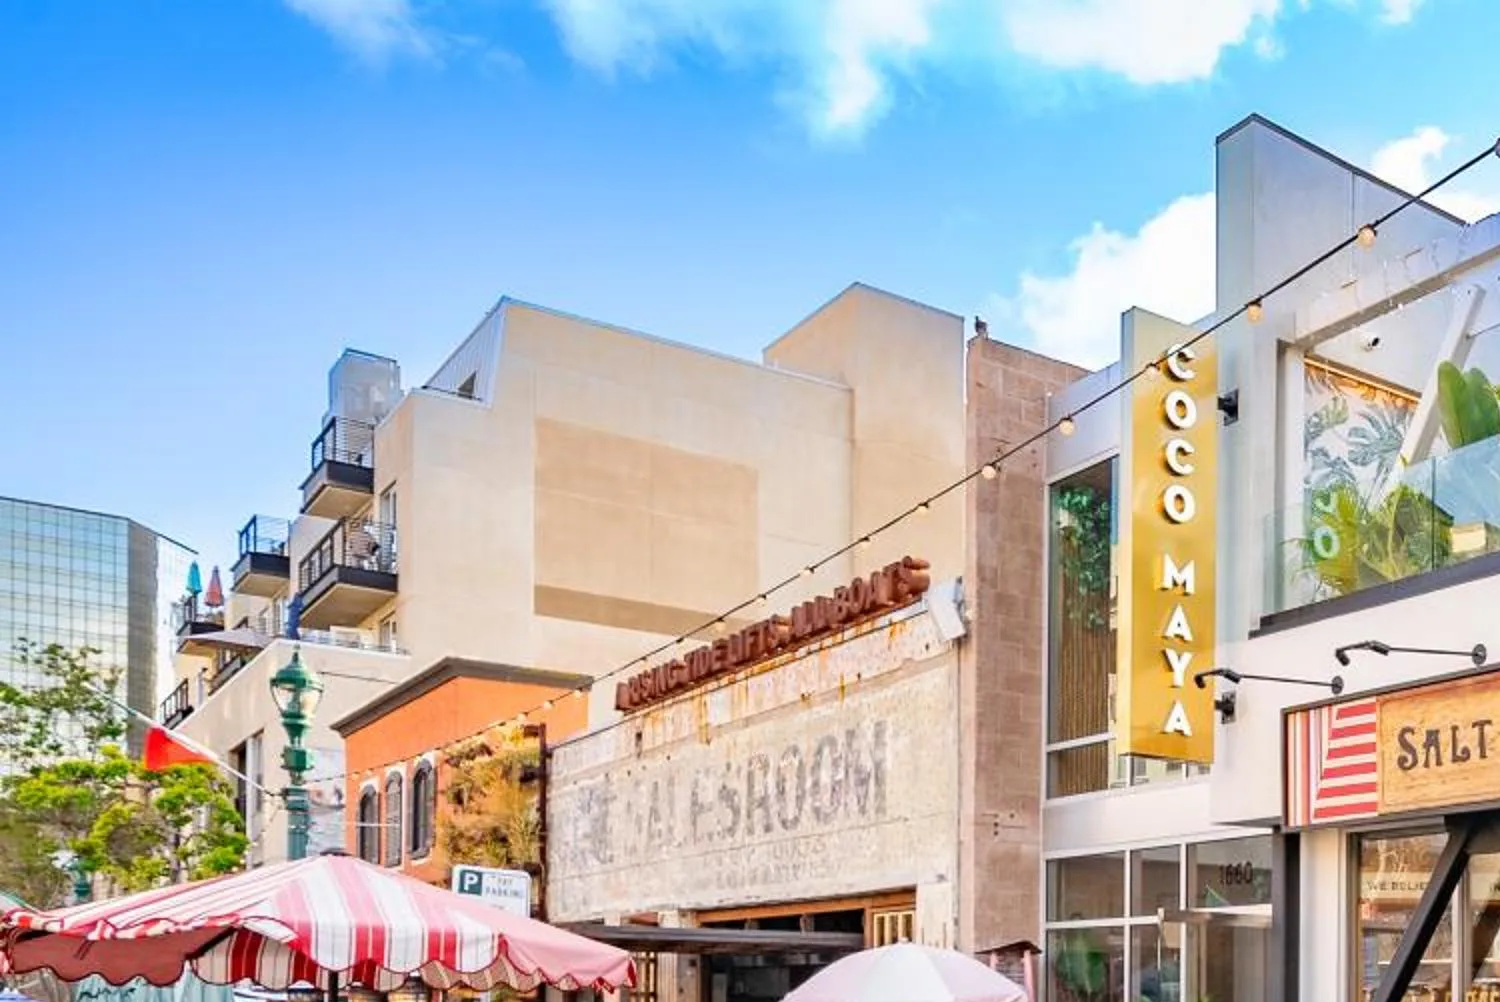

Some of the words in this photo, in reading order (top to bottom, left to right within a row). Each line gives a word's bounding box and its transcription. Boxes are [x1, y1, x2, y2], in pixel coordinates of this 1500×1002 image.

[1163, 343, 1197, 524] COCO
[684, 638, 730, 684] TIDE
[1162, 553, 1196, 737] MAYA
[1397, 719, 1492, 771] SALT
[625, 720, 888, 854] ALESROOM
[464, 873, 478, 890] P
[1219, 861, 1253, 886] 1660
